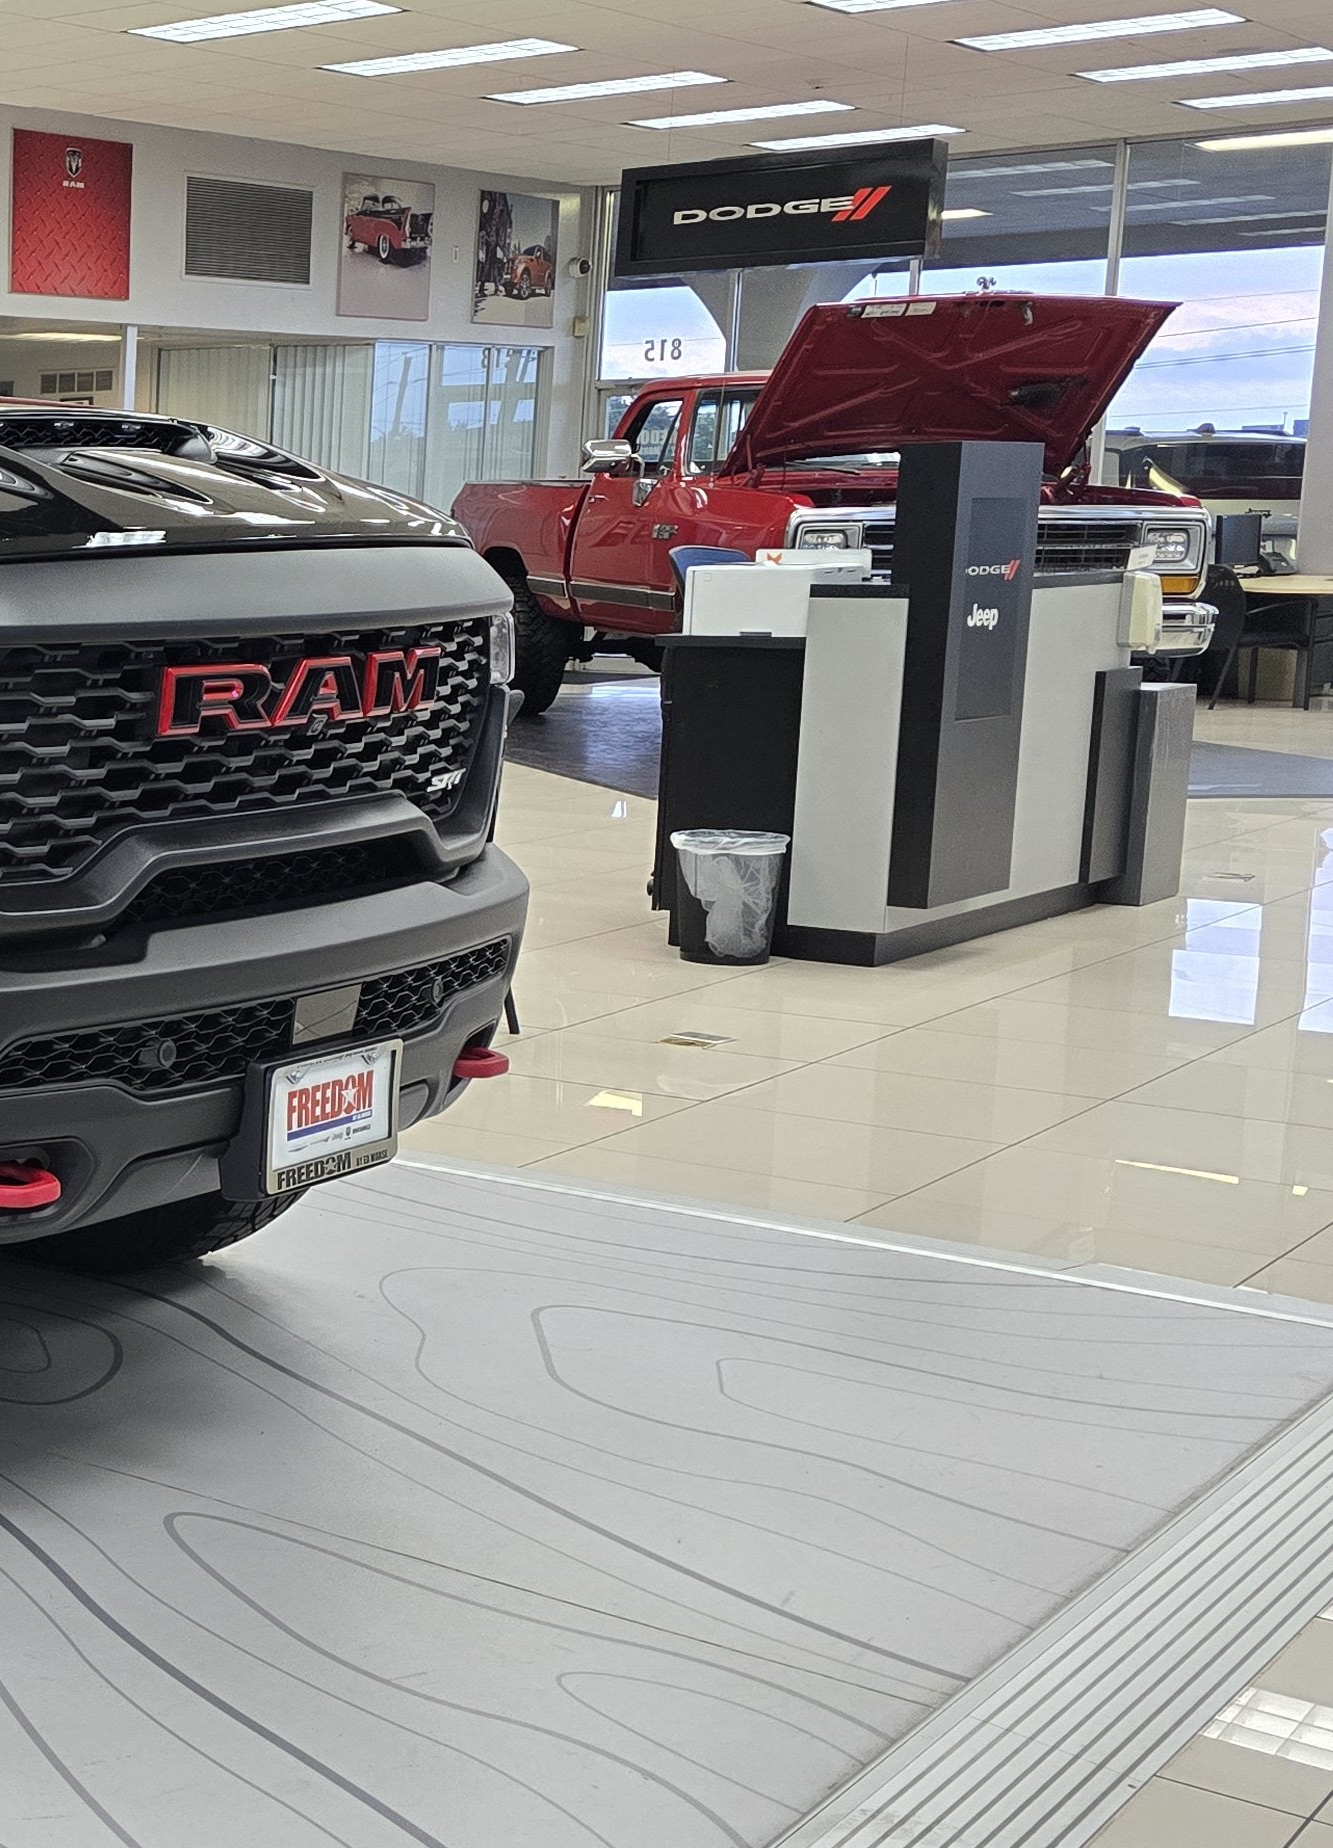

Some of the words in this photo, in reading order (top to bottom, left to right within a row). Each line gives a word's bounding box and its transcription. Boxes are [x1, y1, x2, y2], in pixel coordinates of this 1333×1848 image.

[673, 195, 855, 225] DODGE
[965, 565, 1010, 576] ODGE
[966, 603, 999, 631] Jeep
[157, 646, 441, 736] RAM
[286, 1069, 375, 1132] FREEDOM
[277, 1152, 352, 1191] FREEDOM
